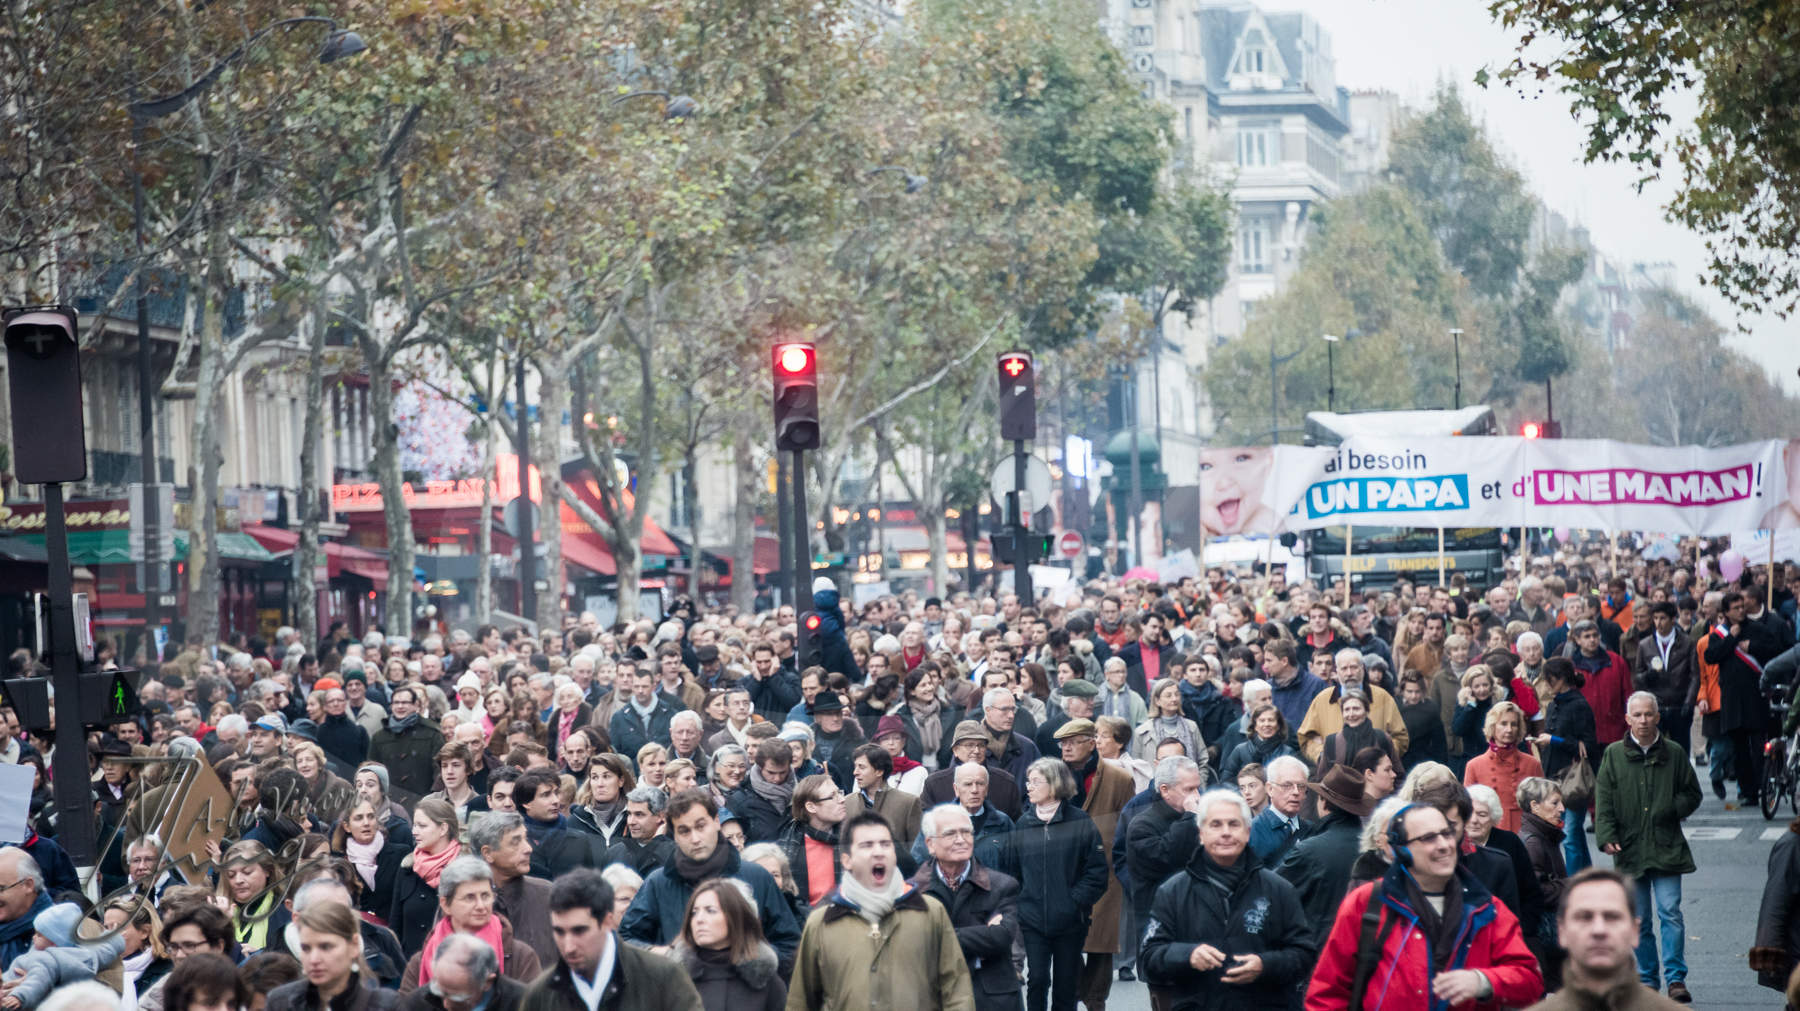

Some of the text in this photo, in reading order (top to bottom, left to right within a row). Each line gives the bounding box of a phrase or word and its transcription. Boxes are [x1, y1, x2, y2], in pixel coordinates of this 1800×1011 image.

[1348, 448, 1426, 471] besoin
[333, 481, 415, 507] PIZA
[1366, 477, 1464, 509] PAPA
[1481, 480, 1502, 500] et
[1615, 468, 1749, 502] MAMAN
